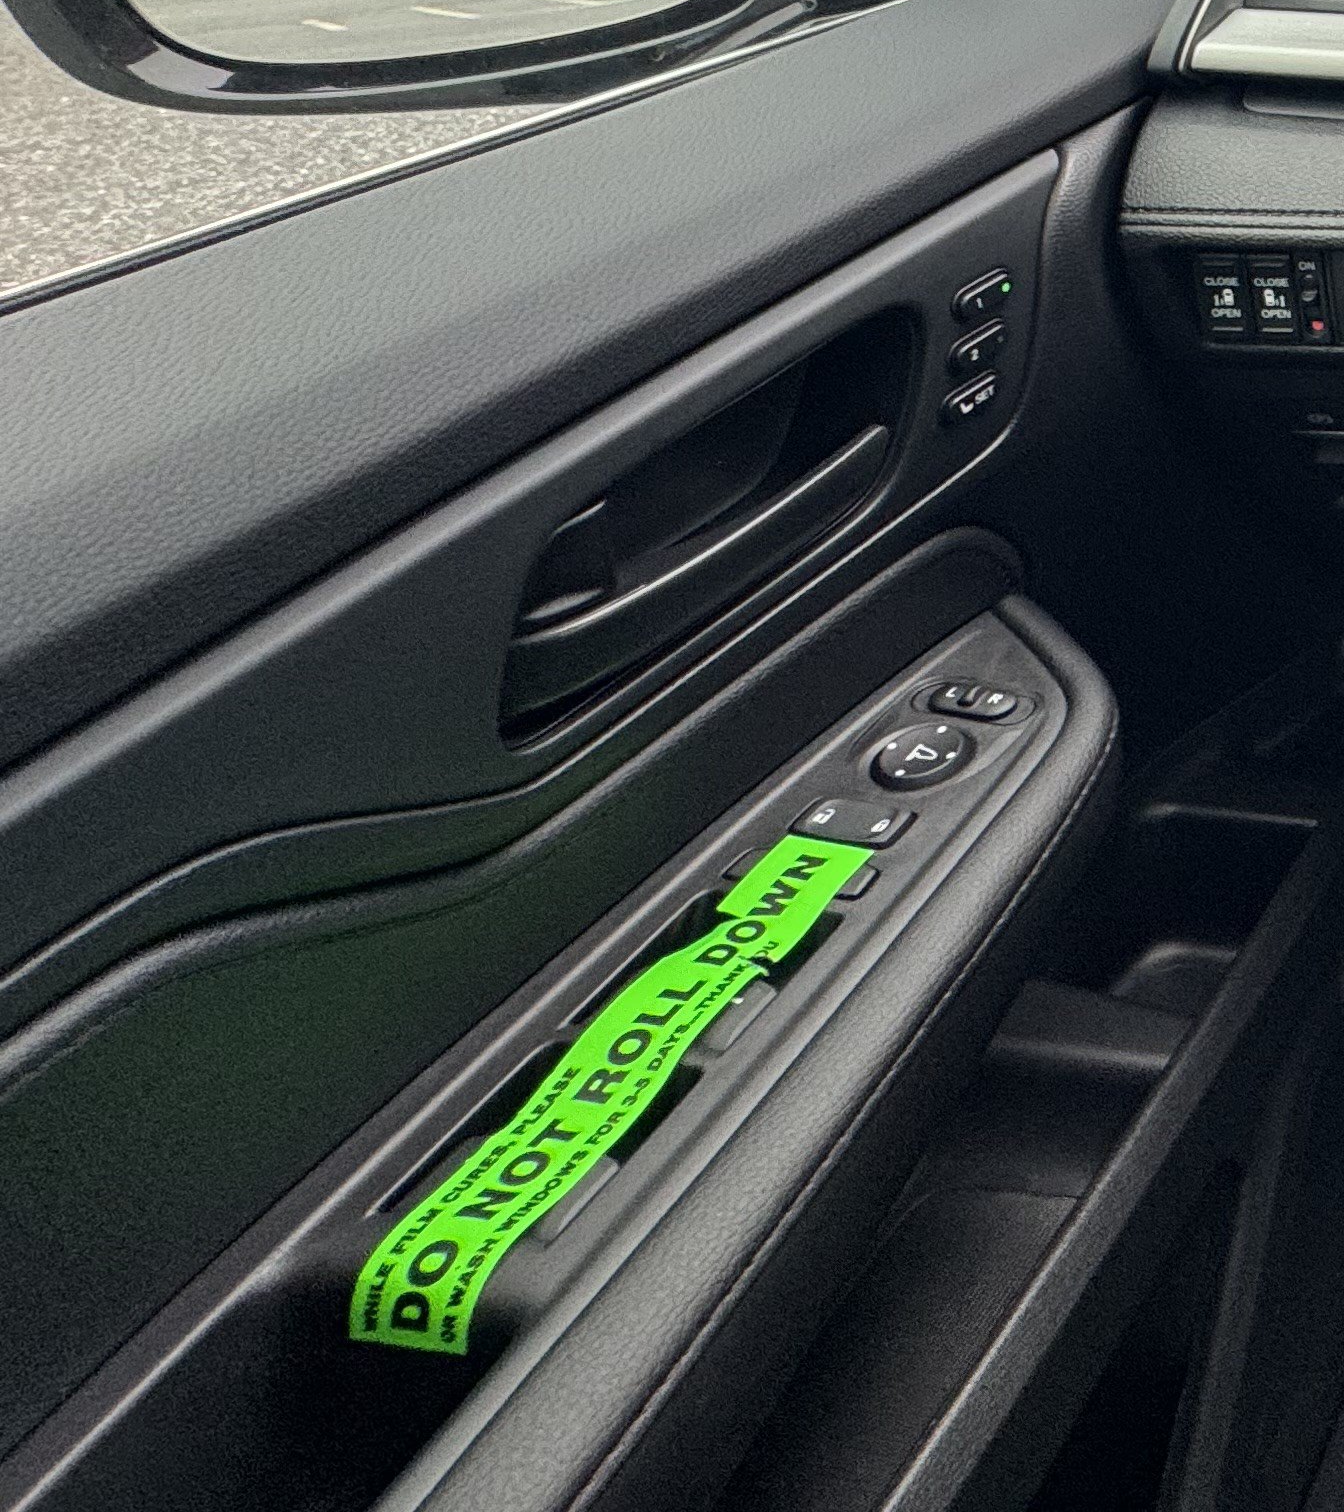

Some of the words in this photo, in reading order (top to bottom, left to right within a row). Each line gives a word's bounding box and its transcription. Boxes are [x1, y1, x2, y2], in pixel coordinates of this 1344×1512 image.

[1298, 261, 1316, 271] ON
[1204, 276, 1240, 287] CLOSE
[1253, 277, 1290, 288] CLOSE
[1211, 308, 1242, 318] OPEN
[1261, 309, 1292, 319] OPEN
[969, 348, 979, 361] 2
[974, 385, 995, 405] SET
[945, 686, 957, 698] L
[987, 692, 1004, 705] R
[391, 1240, 459, 1334] DO
[454, 1118, 582, 1221] NOT
[571, 978, 709, 1105] ROLL
[691, 854, 828, 967] DOWN
[390, 1207, 444, 1256] FILM
[511, 1067, 582, 1135] PLEASE
[446, 1238, 501, 1309] WASH
[494, 1149, 590, 1233] WINDOWS
[584, 1110, 625, 1147] FOR
